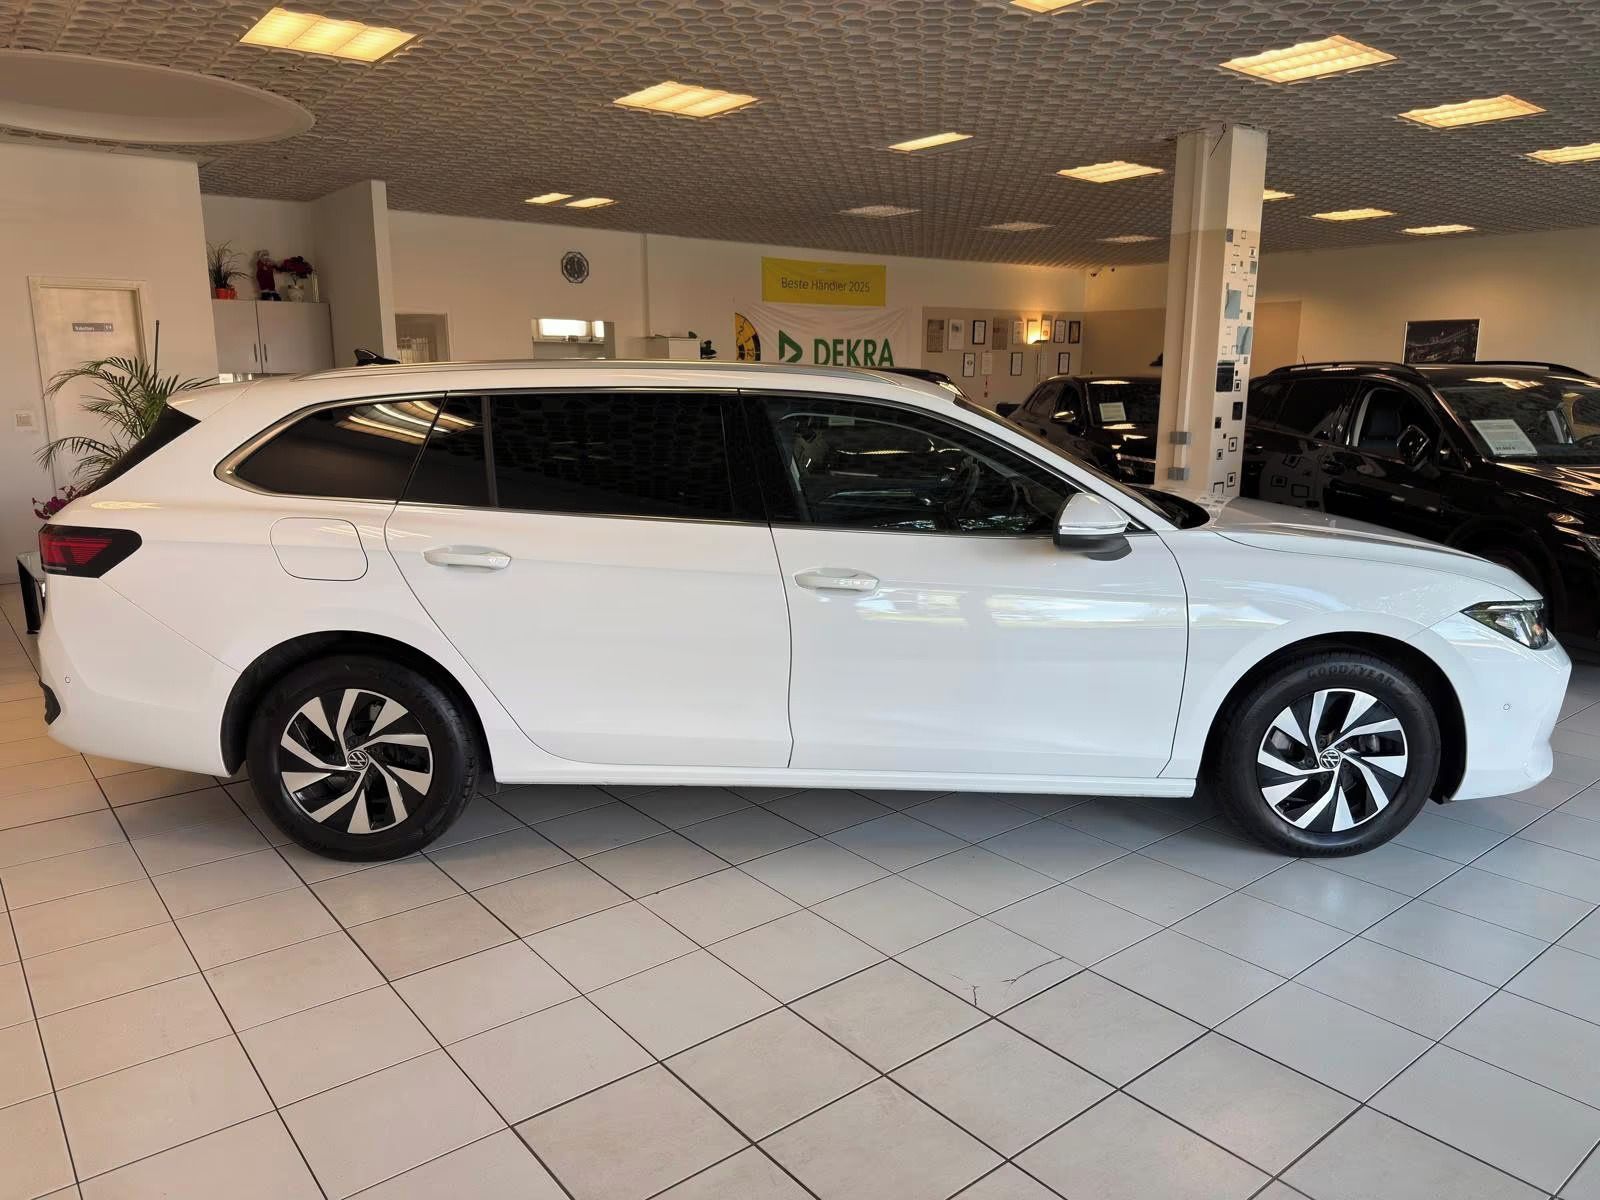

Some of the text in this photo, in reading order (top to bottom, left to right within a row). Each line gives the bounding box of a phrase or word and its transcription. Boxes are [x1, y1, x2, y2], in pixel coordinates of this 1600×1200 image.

[781, 277, 871, 294] Beste Händler 2025
[813, 337, 895, 368] DEKRA
[1307, 663, 1396, 688] GOODYEAR
